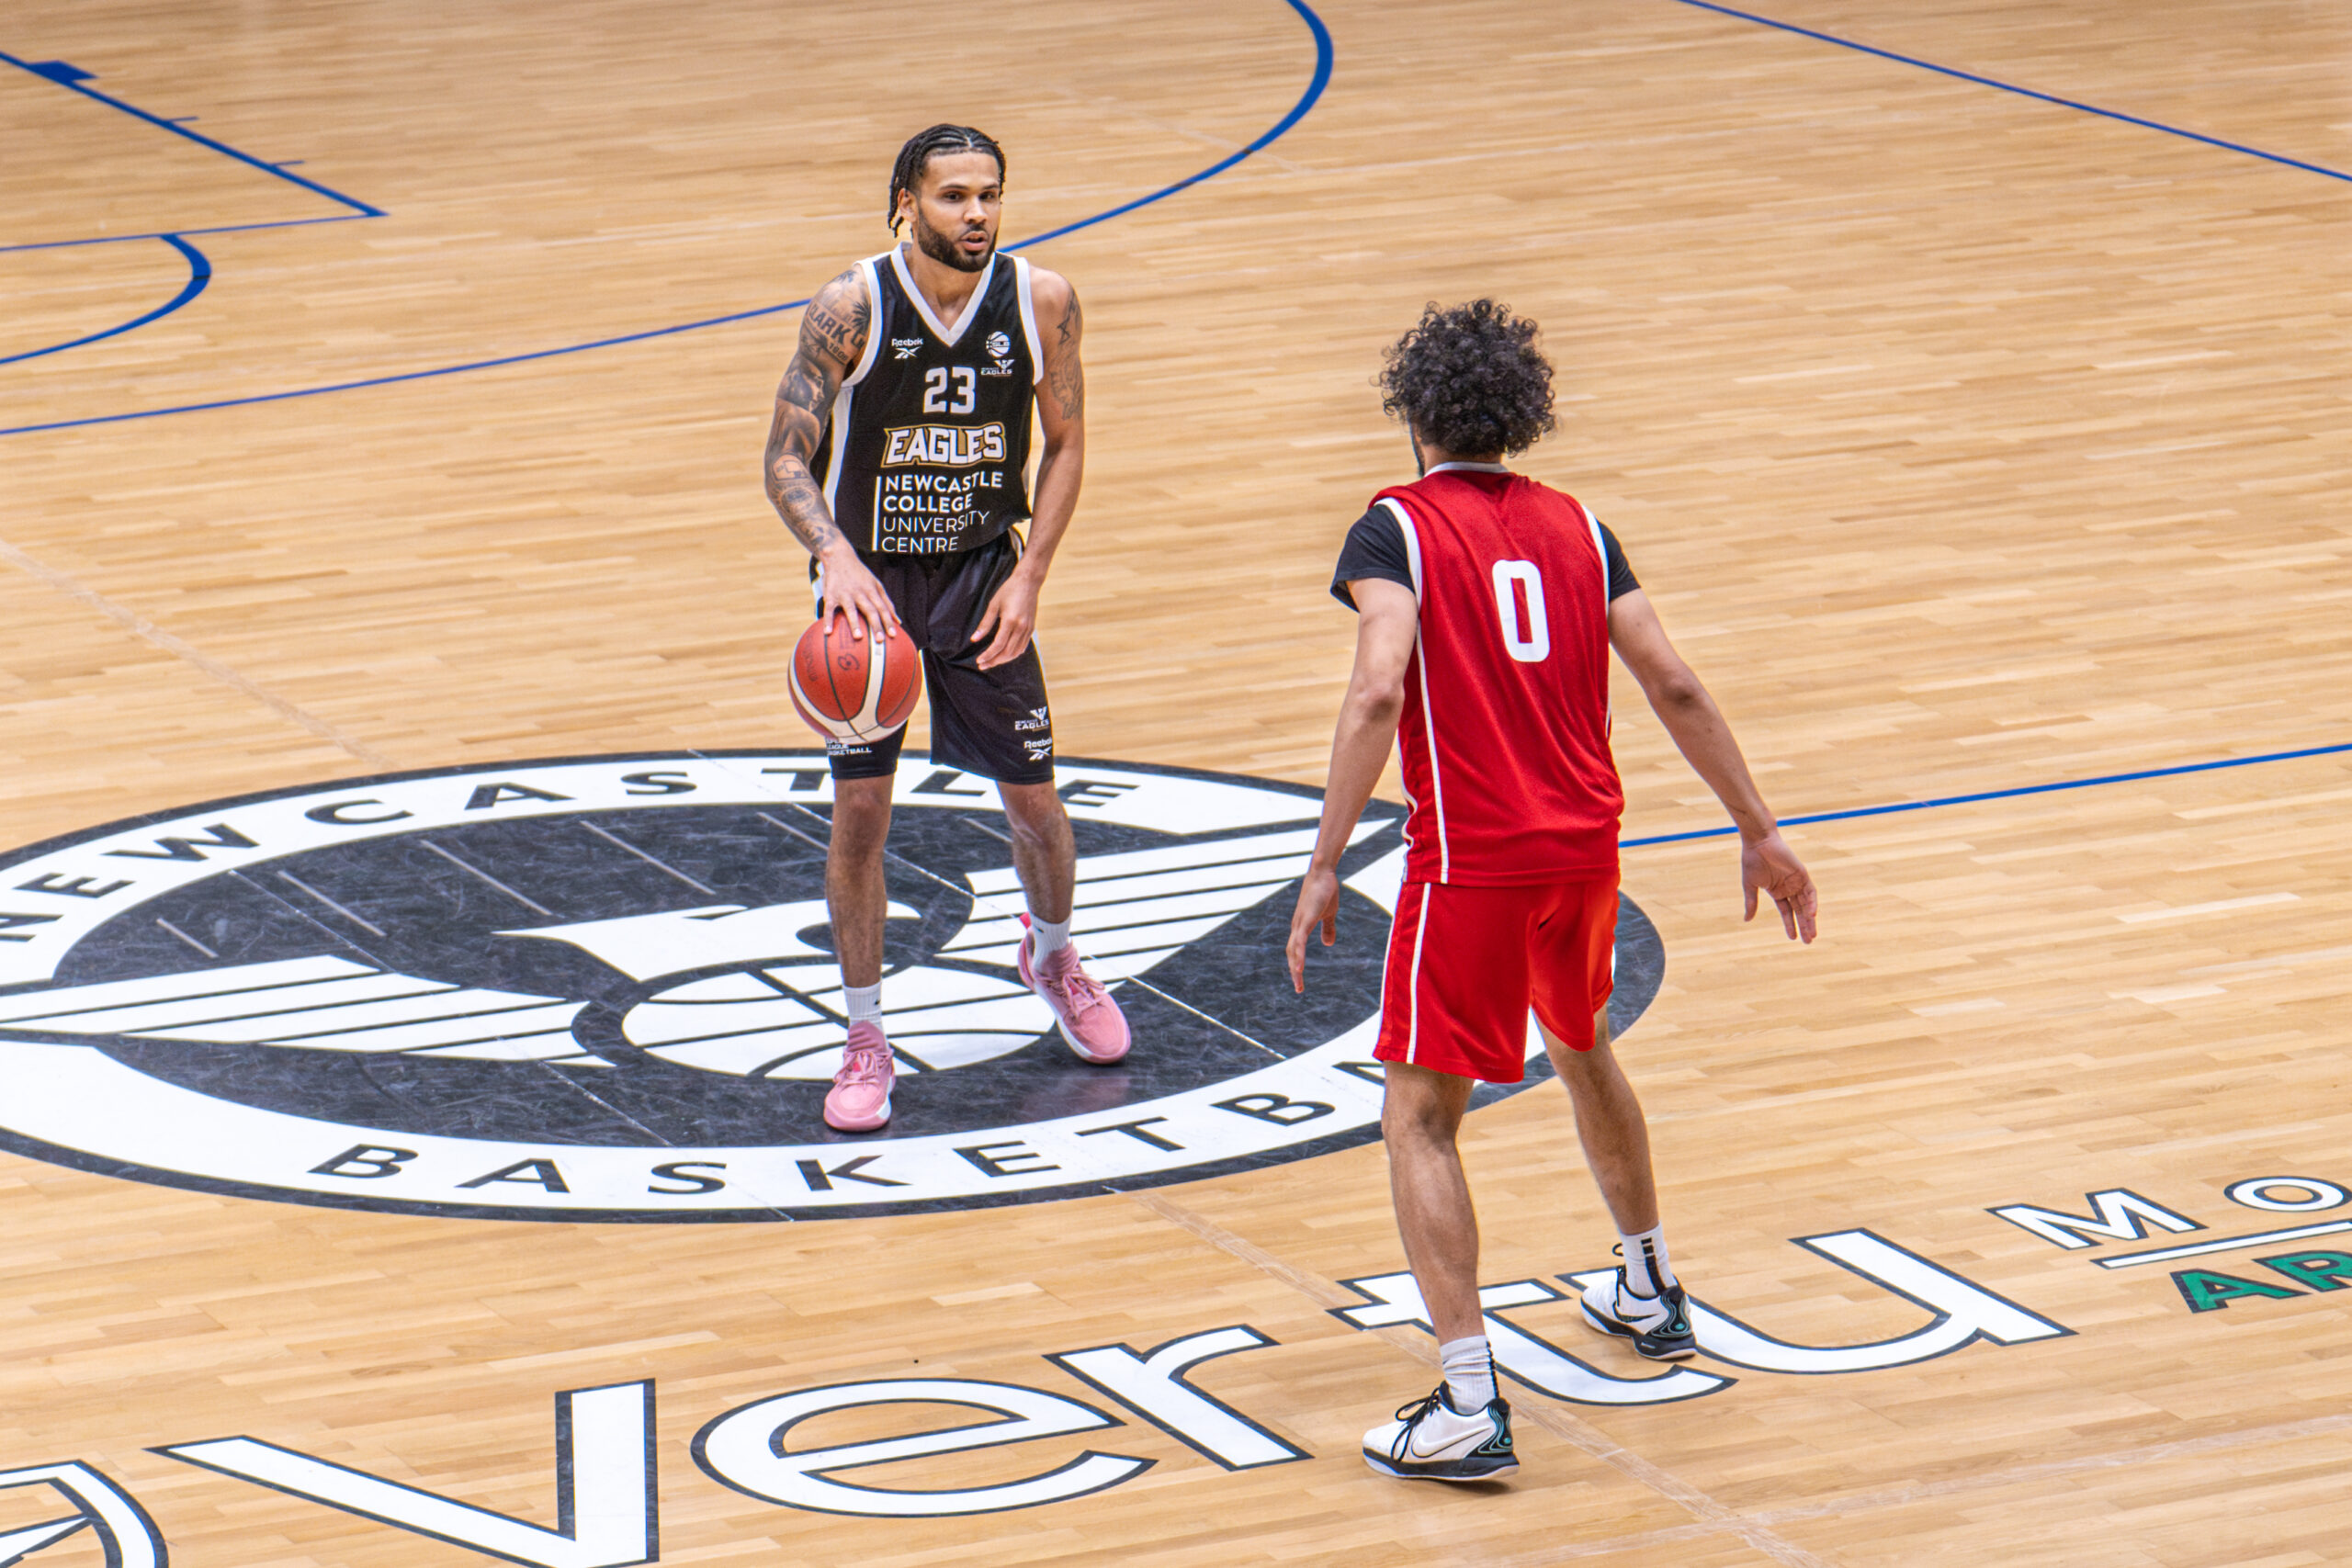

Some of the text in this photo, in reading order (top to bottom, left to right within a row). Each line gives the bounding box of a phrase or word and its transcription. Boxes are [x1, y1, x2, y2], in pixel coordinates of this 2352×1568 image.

[891, 337, 924, 347] Reebok
[923, 367, 976, 413] 23
[882, 423, 1006, 467] EAGLES
[885, 470, 1003, 493] NEWCASTLE
[883, 492, 973, 513] COLLEGE
[883, 510, 989, 533] UNIVERSITY
[881, 536, 959, 553] CENTRE
[1492, 558, 1550, 662] 0
